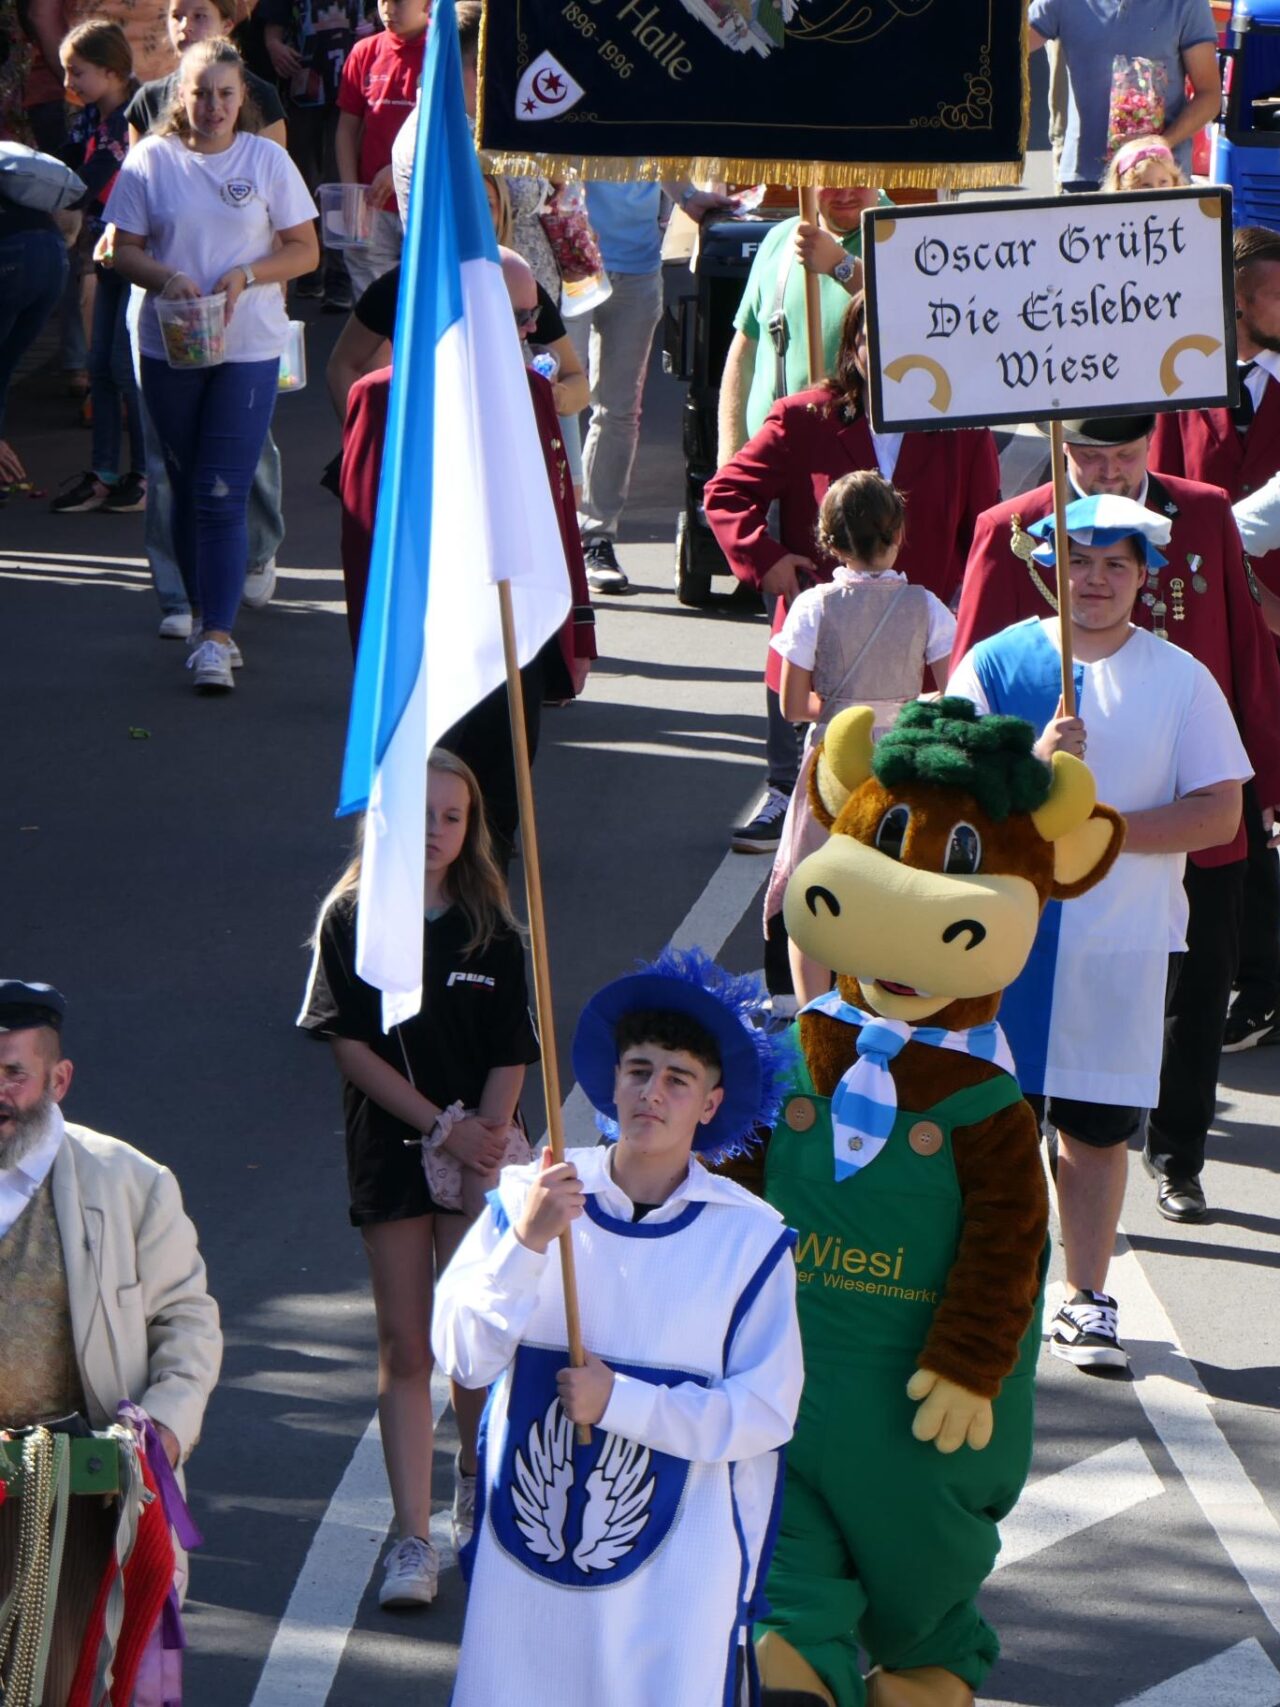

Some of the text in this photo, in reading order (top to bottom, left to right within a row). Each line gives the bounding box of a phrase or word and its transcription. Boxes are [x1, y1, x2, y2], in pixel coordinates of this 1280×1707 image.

[616, 0, 692, 80] Halle
[914, 214, 1187, 276] Oscar Grüßt
[925, 280, 1183, 339] Die Eisleber
[996, 344, 1120, 389] Wiese
[795, 1231, 904, 1281] Wiesi
[797, 1270, 937, 1304] er Wiesenmarkt
